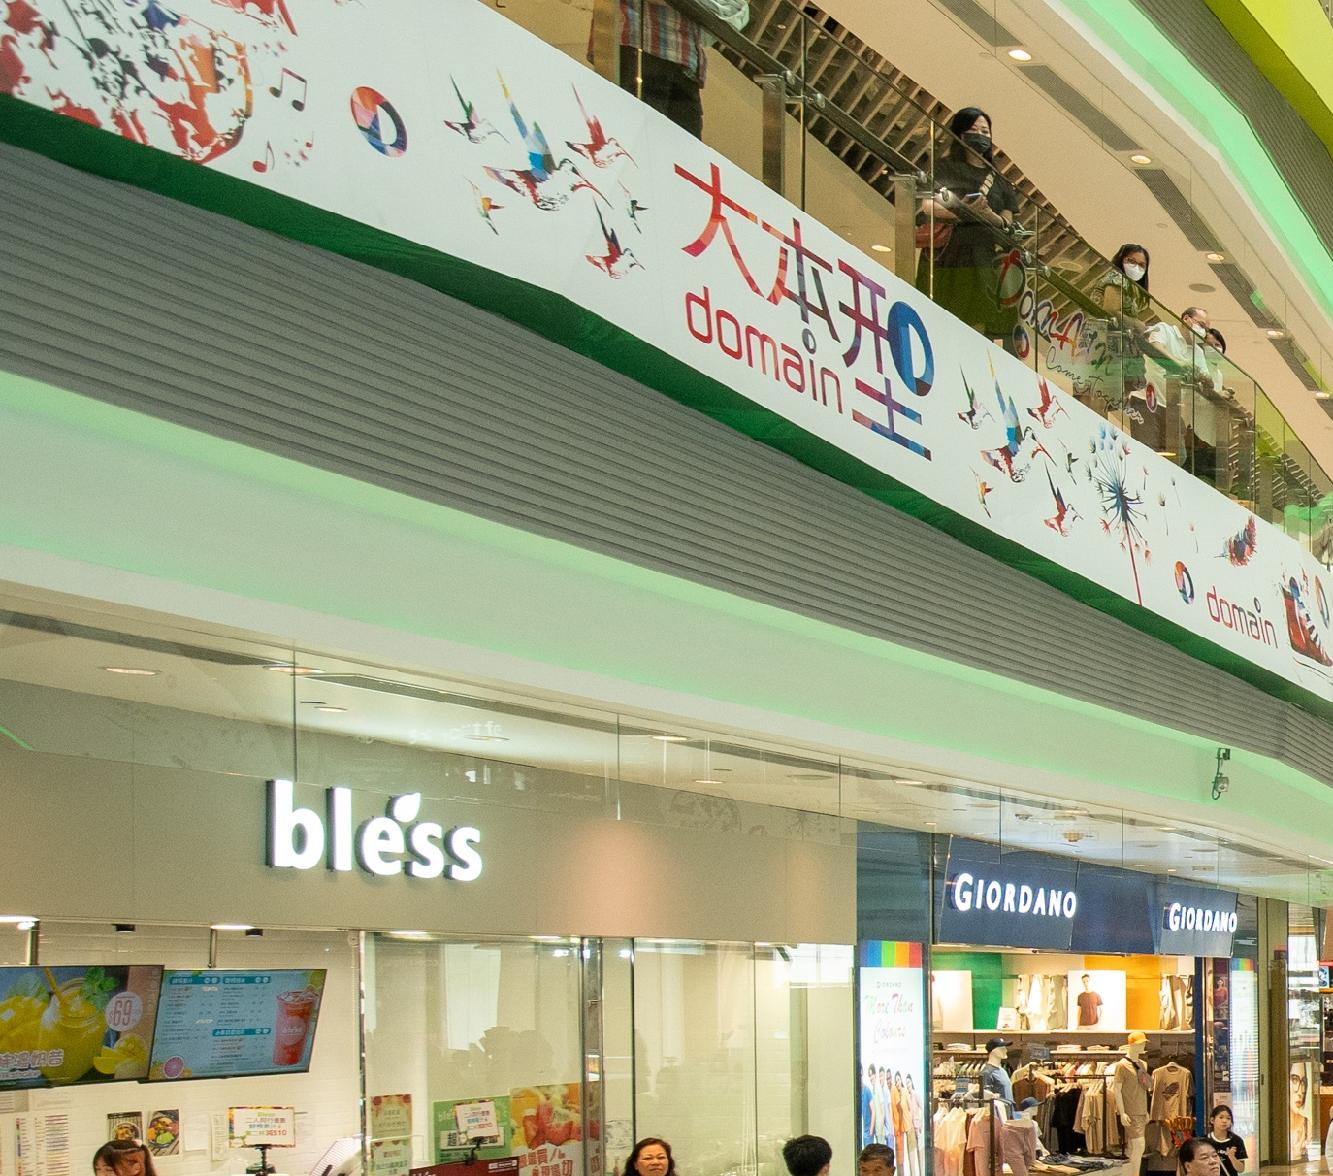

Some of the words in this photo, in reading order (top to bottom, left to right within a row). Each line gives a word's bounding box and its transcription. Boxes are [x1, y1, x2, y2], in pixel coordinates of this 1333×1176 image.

[685, 286, 844, 415] domain
[1206, 589, 1278, 649] domain
[267, 779, 483, 882] bless
[953, 873, 1077, 919] GIORDANO
[1168, 902, 1238, 933] GIORDANO
